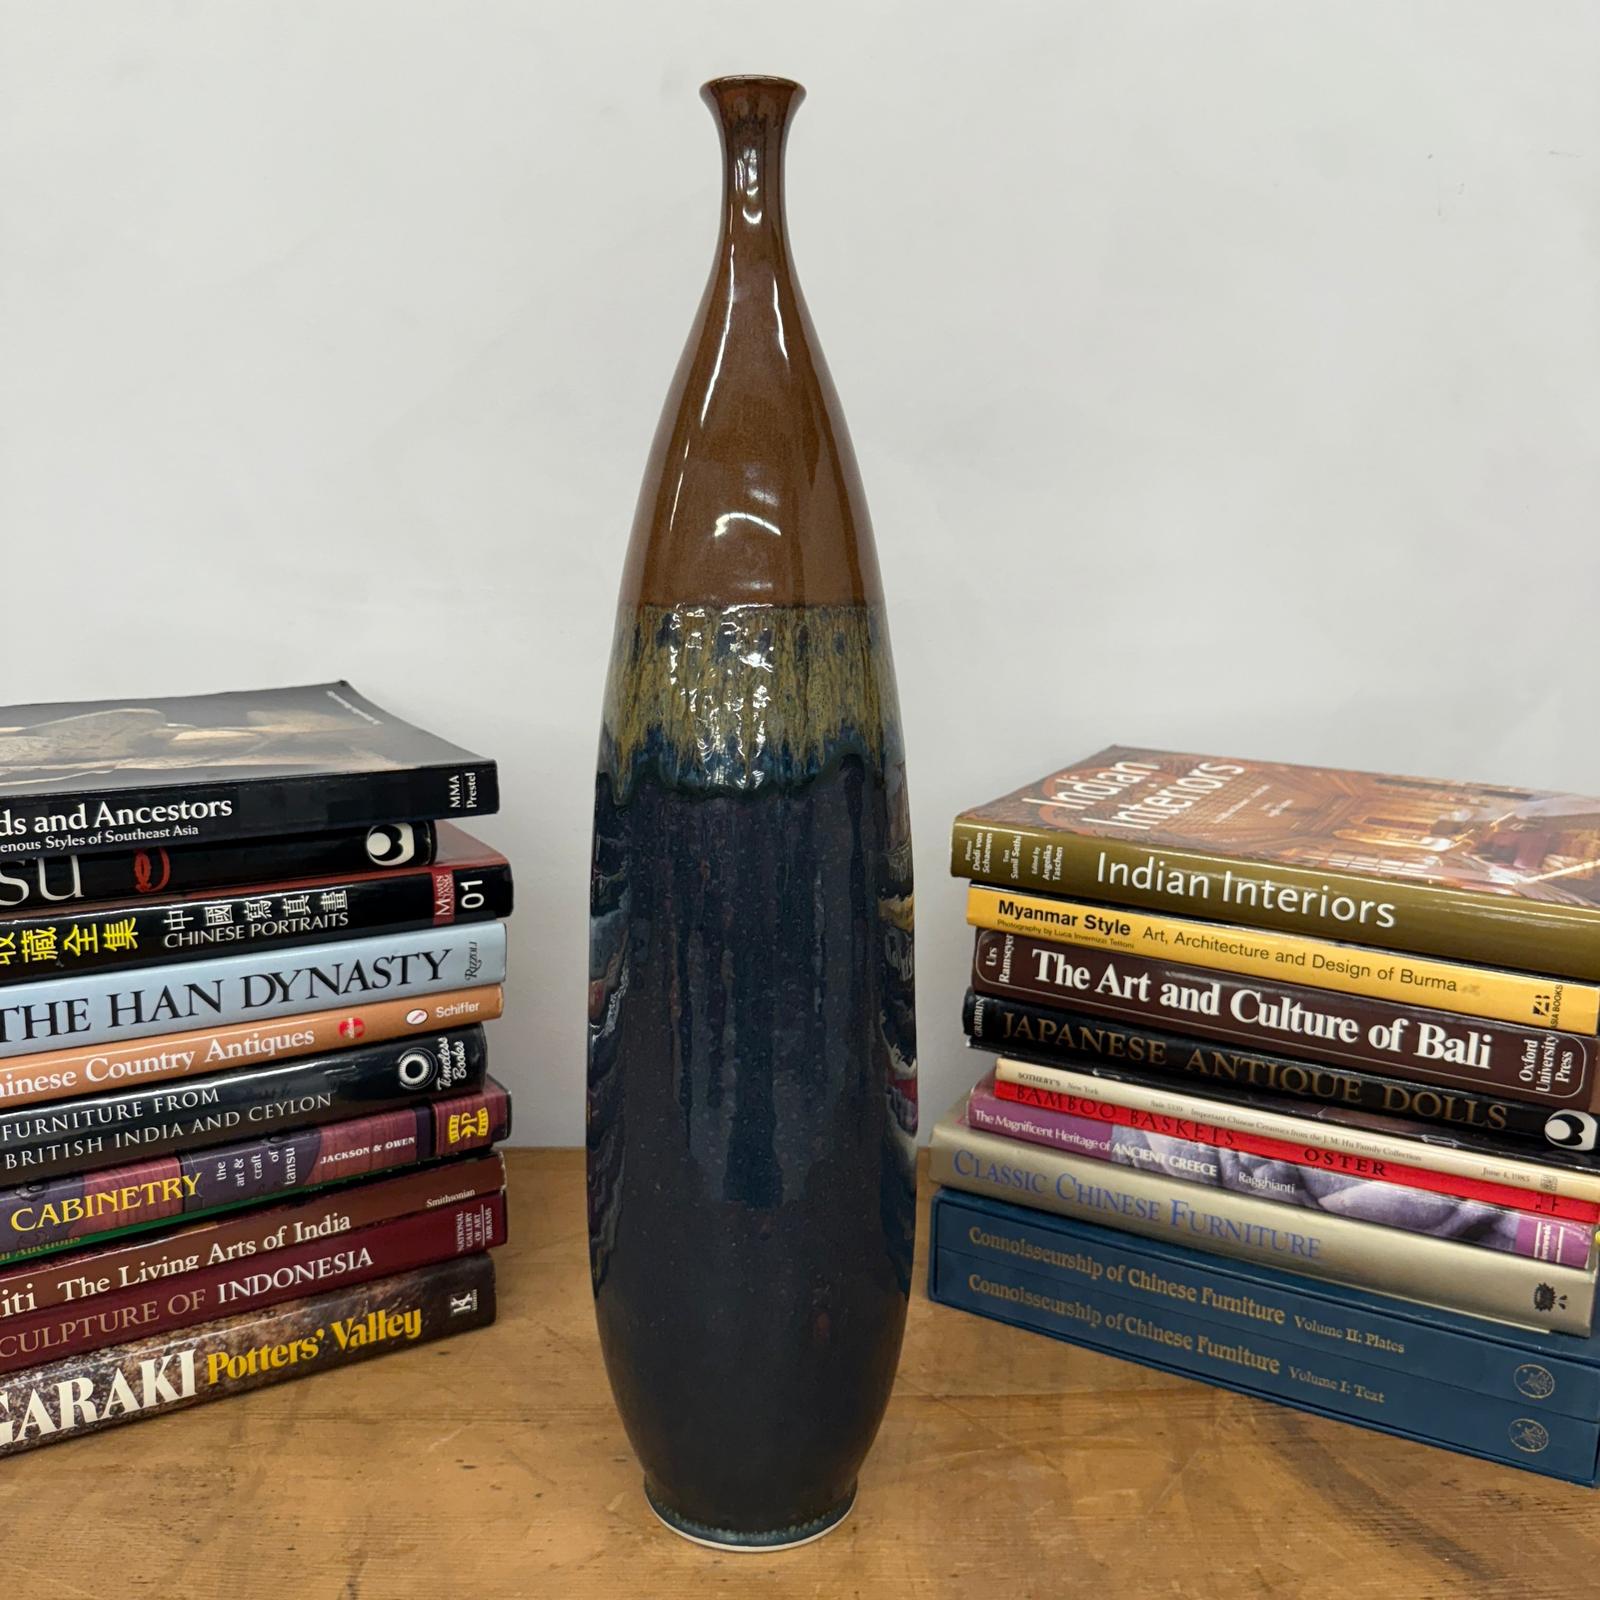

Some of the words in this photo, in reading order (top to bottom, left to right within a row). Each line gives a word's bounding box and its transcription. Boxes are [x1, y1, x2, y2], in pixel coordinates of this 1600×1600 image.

[450, 775, 461, 808] MMA
[465, 772, 477, 808] Prestel
[1021, 760, 1160, 810] Indian
[1081, 762, 1245, 830] Interiors
[0, 809, 27, 836] ds
[34, 803, 91, 834] and
[94, 800, 233, 828] Ancestors
[1, 841, 41, 853] enous
[45, 835, 86, 850] Styles
[89, 831, 102, 844] of
[105, 827, 171, 843] Southeast
[172, 825, 199, 836] Asia
[1042, 845, 1052, 880] Angelika
[1052, 847, 1063, 880] Taschen
[461, 880, 484, 909] 01
[1097, 852, 1209, 899] Indian
[1223, 871, 1396, 928] Interiors
[164, 926, 245, 948] CHINESE
[251, 912, 349, 937] PORTRAITS
[997, 919, 1041, 934] Photography
[1044, 928, 1052, 937] by
[1055, 929, 1072, 938] Luca
[998, 900, 1078, 926] Myanmar
[1084, 915, 1131, 936] Style
[1142, 926, 1168, 944] Art,
[1174, 932, 1269, 960] Architecture
[1275, 949, 1305, 966] and
[1312, 954, 1370, 979] Design
[1377, 966, 1394, 981] of
[1400, 970, 1457, 992] Burma
[986, 947, 997, 966] Urs
[999, 934, 1015, 984] Ramseyer
[0, 998, 91, 1042] THE
[107, 979, 224, 1028] HAN
[240, 949, 453, 1008] DYNASTY
[436, 1001, 480, 1019] Schiffer
[1032, 949, 1091, 990] The
[1095, 963, 1152, 1002] Art
[1159, 979, 1221, 1017] and
[1230, 989, 1359, 1044] Culture
[1368, 1018, 1408, 1052] of
[1413, 1022, 1493, 1069] Bali
[1553, 984, 1563, 1012] BOOKS
[86, 1050, 196, 1083] Country
[205, 1030, 315, 1062] Antiques
[437, 1037, 452, 1090] Timeless
[451, 1040, 467, 1080] Books
[1003, 1012, 1167, 1065] JAPANESE
[1185, 1048, 1363, 1102] ANTIQUE
[1384, 1084, 1508, 1129] DOLLS
[1519, 1040, 1538, 1081] Oxford
[1536, 1034, 1559, 1092] University
[1555, 1051, 1573, 1083] Press
[2, 1101, 144, 1142] FURNITURE
[153, 1088, 220, 1114] FROM
[4, 1136, 103, 1170] BRITISH
[115, 1122, 184, 1148] INDIA
[191, 1111, 241, 1134] AND
[248, 1092, 332, 1122] CEYLON
[1016, 1086, 1116, 1119] BAMBOO
[1130, 1111, 1236, 1146] BASKETS
[1304, 1147, 1386, 1176] OSTER
[234, 1158, 245, 1169] &
[251, 1154, 262, 1180] craft
[268, 1149, 279, 1163] of
[284, 1147, 297, 1185] tansu
[319, 1147, 370, 1164] JACKSON
[372, 1144, 382, 1153] &
[385, 1137, 416, 1149] OWEN
[975, 1110, 994, 1125] The
[995, 1116, 1053, 1139] Magnificent
[1055, 1129, 1098, 1150] Heritage
[1099, 1139, 1111, 1152] of
[1112, 1142, 1166, 1165] ANCIENT
[1169, 1154, 1217, 1177] GREECE
[1238, 1171, 1295, 1195] Ragghianti
[216, 1161, 227, 1182] the
[235, 1172, 245, 1187] art
[10, 1172, 202, 1232] CABINETRY
[426, 1189, 475, 1208] Smithsonian
[953, 1150, 1048, 1194] CLASSIC
[1055, 1171, 1160, 1222] CHINESE
[1169, 1199, 1322, 1259] FURNITURE
[456, 1211, 464, 1252] NATIONAL
[465, 1212, 473, 1247] GALLERY
[485, 1208, 493, 1239] ABRAMS
[57, 1276, 110, 1301] The
[118, 1255, 199, 1288] Living
[207, 1240, 256, 1265] Arts
[264, 1226, 287, 1250] of
[294, 1212, 351, 1243] India
[0, 1300, 160, 1357] CULPTURE
[168, 1289, 206, 1315] OF
[218, 1247, 374, 1304] INDONESIA
[969, 1226, 1103, 1280] Connoisseurship
[1106, 1265, 1125, 1281] of
[1128, 1268, 1196, 1303] Chinese
[1201, 1287, 1286, 1325] Furniture
[1294, 1314, 1343, 1339] Volume
[1345, 1328, 1362, 1343] II:
[1365, 1332, 1405, 1354] Plates
[331, 1308, 422, 1350] Valley
[968, 1273, 1101, 1328] Connoisseurship
[1105, 1313, 1123, 1331] of
[1125, 1317, 1193, 1352] Chinese
[1197, 1335, 1280, 1375] Furniture
[1288, 1366, 1337, 1392] Volume
[1354, 1384, 1385, 1404] Text
